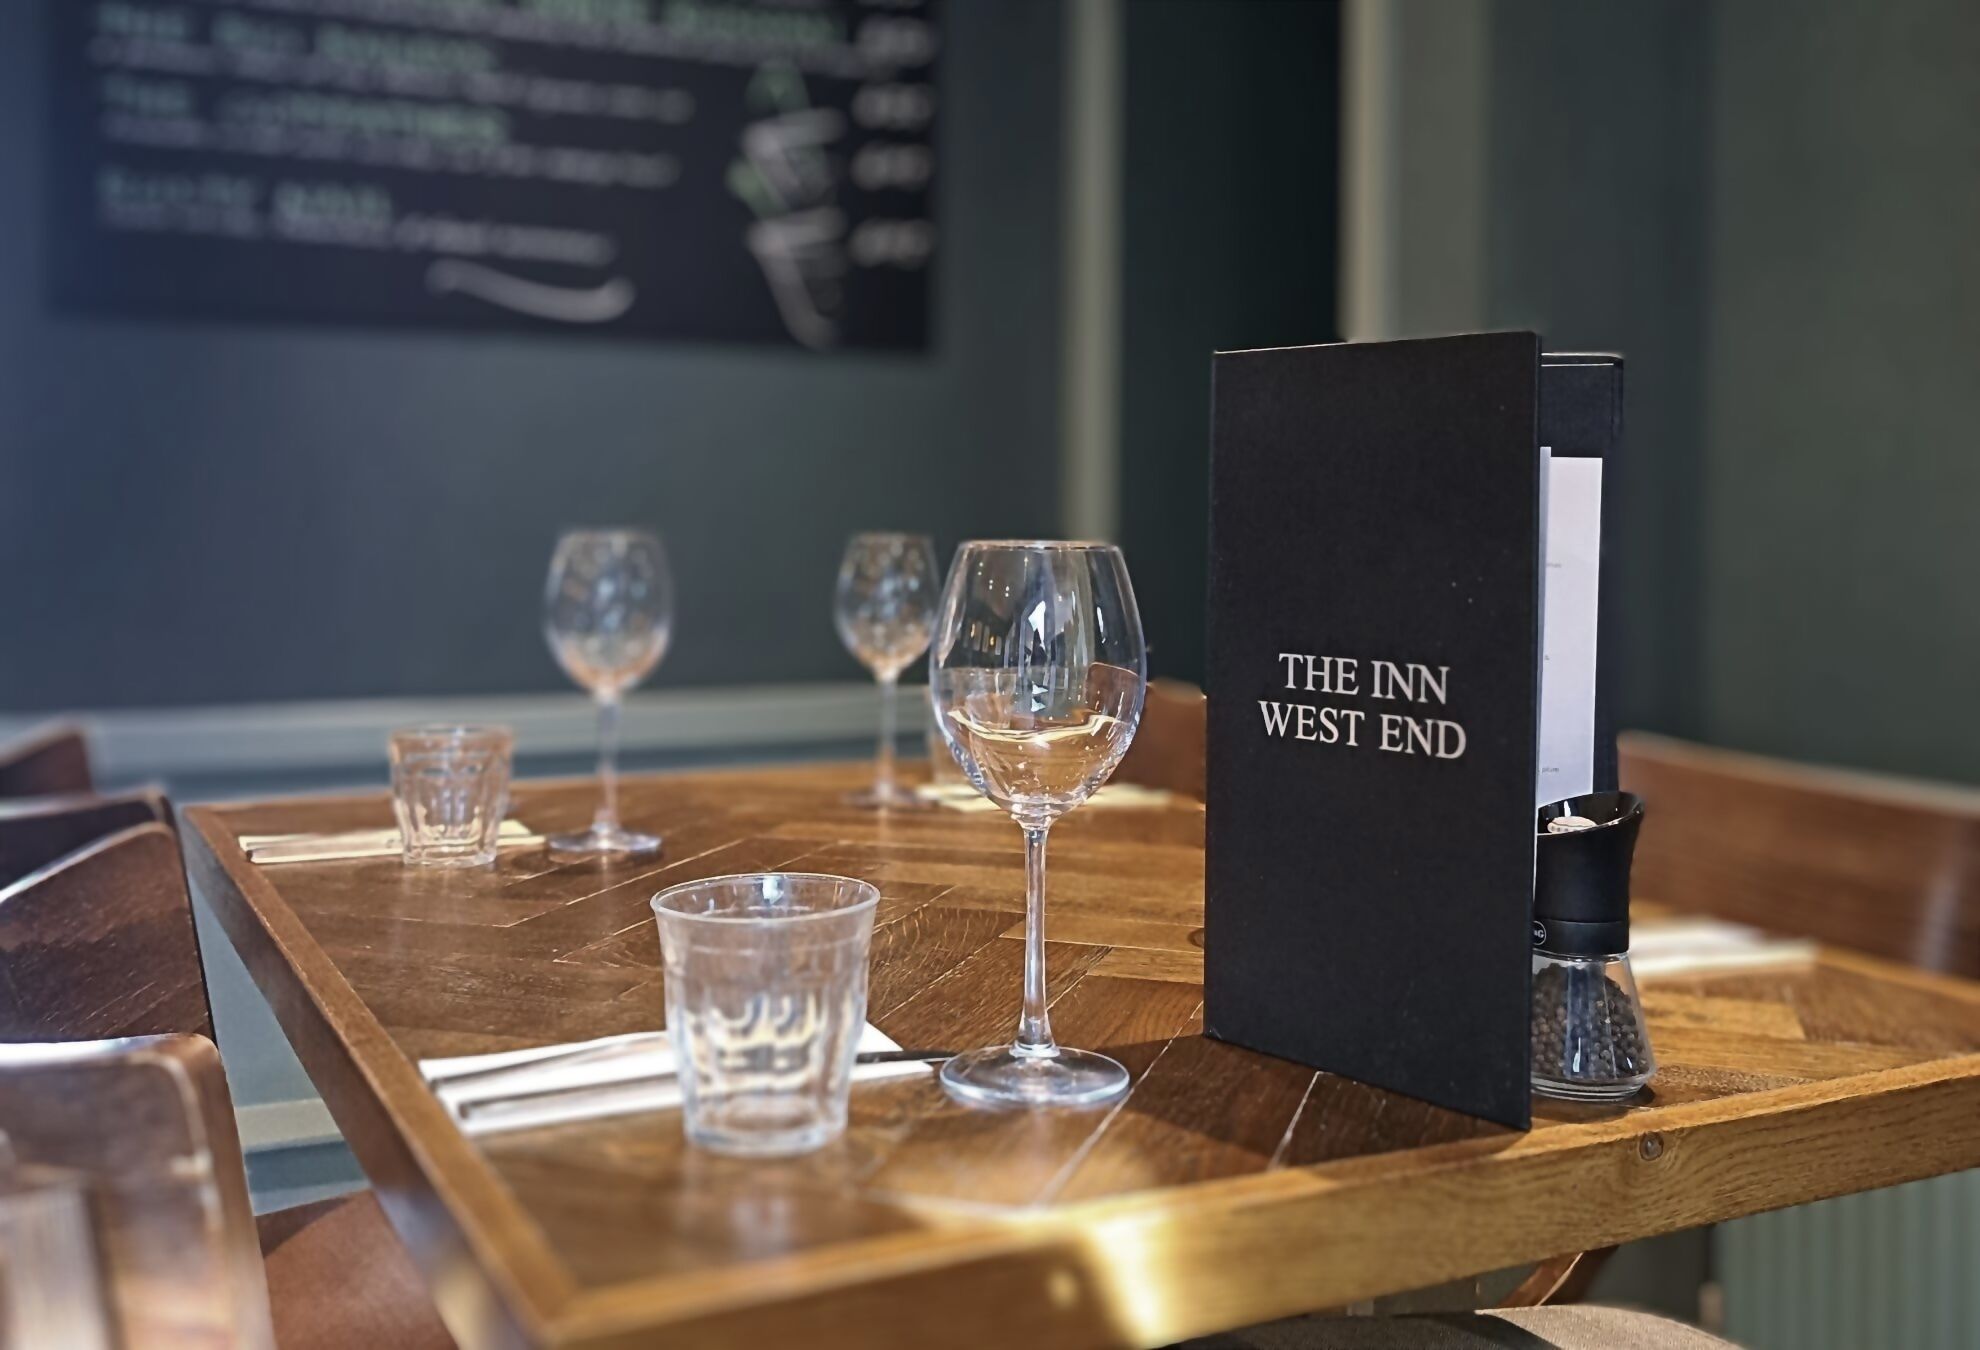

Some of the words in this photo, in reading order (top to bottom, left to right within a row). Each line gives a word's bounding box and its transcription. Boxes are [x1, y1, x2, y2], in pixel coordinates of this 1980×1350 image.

[1278, 652, 1360, 696] THE
[1370, 660, 1450, 705] INN
[1257, 700, 1365, 747] WEST
[1379, 713, 1467, 759] END
